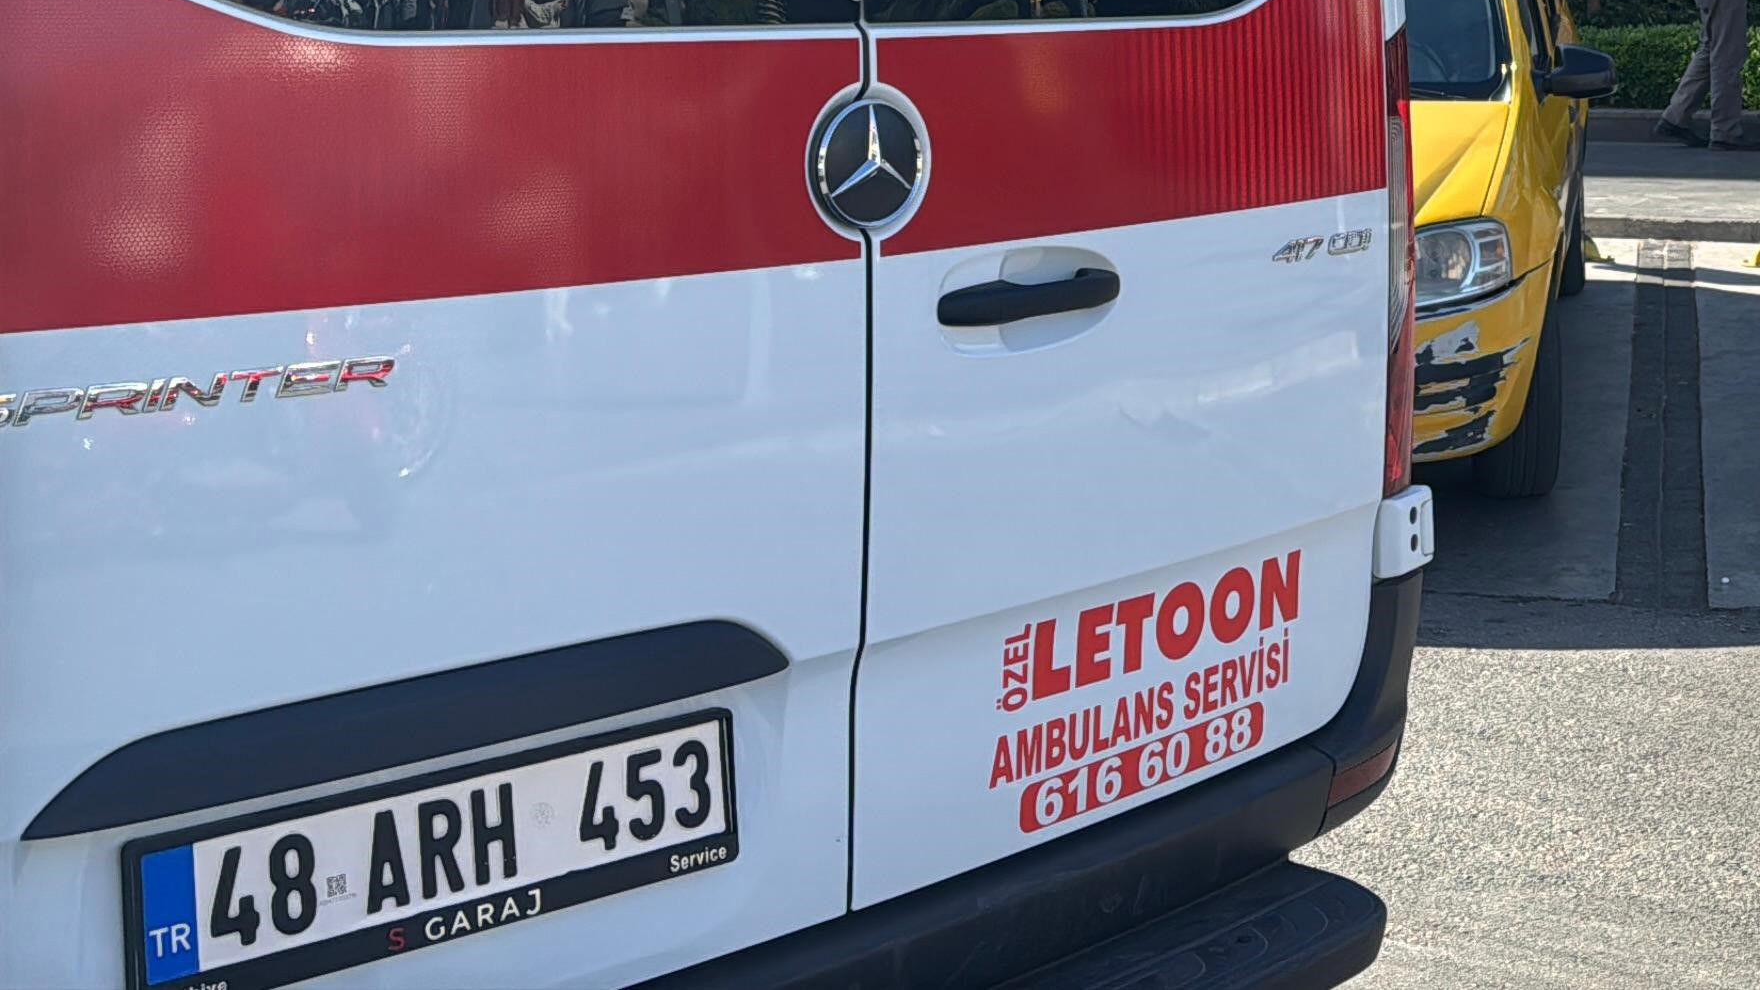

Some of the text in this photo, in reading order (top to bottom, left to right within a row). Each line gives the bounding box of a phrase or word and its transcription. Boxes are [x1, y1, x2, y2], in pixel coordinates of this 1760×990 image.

[1272, 236, 1324, 263] 417
[995, 623, 1032, 712] ÖZEL
[1032, 549, 1301, 701] LETOON
[989, 628, 1290, 789] AMBULANS SERVİSİ
[1035, 708, 1252, 826] 616 60 88
[149, 740, 711, 957] TR 48 ARH 453
[670, 845, 727, 872] Service
[386, 889, 542, 951] S GARAJ
